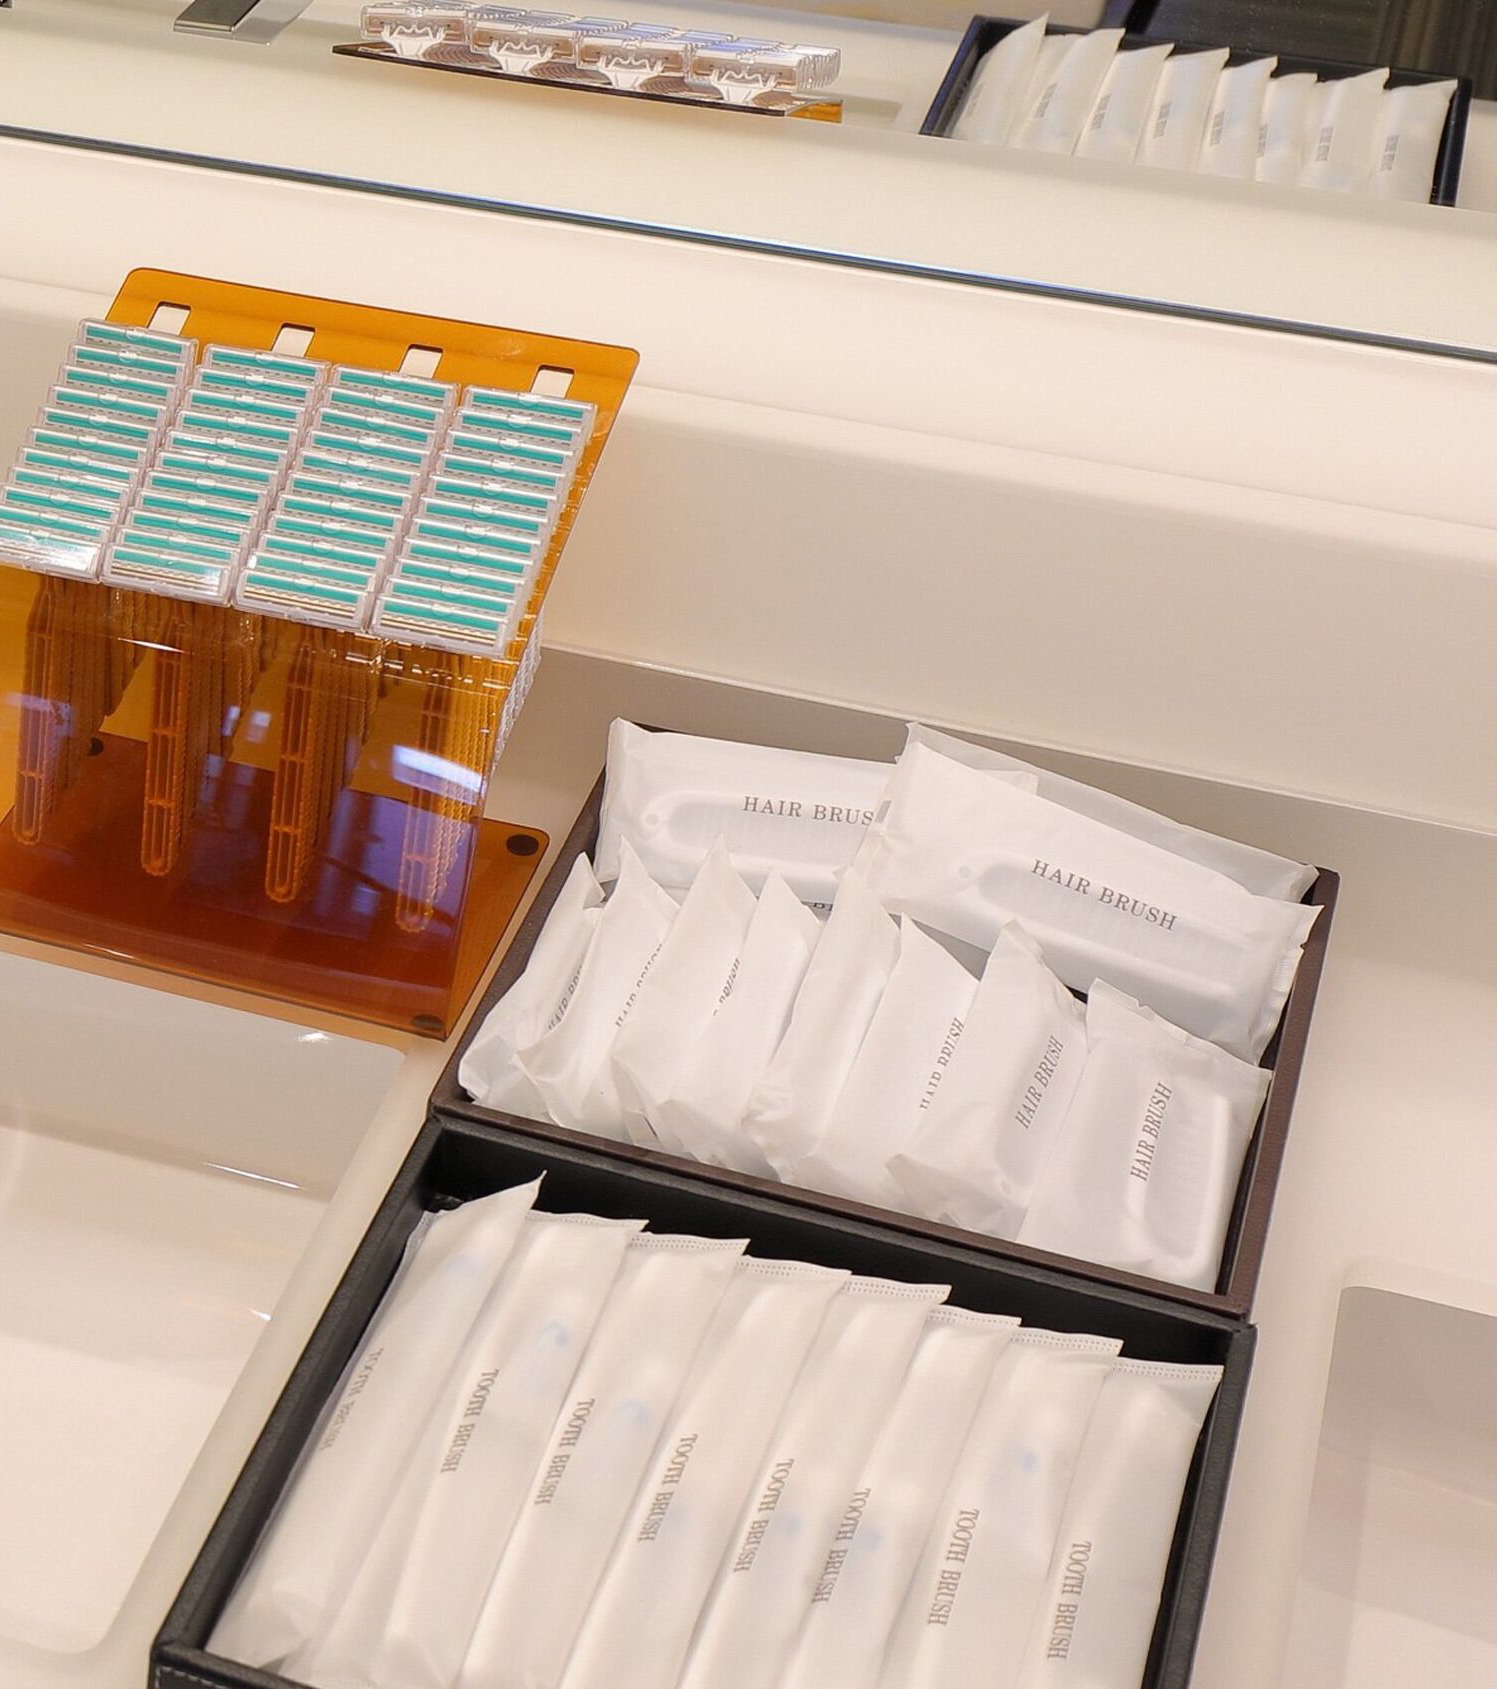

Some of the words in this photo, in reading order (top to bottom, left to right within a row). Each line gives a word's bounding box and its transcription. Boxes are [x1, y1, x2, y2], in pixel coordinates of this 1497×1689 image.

[742, 796, 802, 818] HAIR
[813, 804, 874, 827] BRUS
[1031, 859, 1091, 895] HAIR
[1098, 887, 1177, 931] BRUSH
[1015, 1085, 1043, 1130] HAIR
[1034, 1035, 1064, 1088] BRUSH
[1142, 1082, 1172, 1138] BRUSH
[1130, 1139, 1155, 1181] HAIR
[464, 1369, 499, 1418] TOOTH
[440, 1423, 475, 1474] BRUSH
[559, 1398, 595, 1447] TOOTH
[534, 1454, 570, 1506] BRUSH
[662, 1434, 698, 1485] TOOTH
[758, 1458, 794, 1512] TOOTH
[638, 1491, 674, 1543] BRUSH
[836, 1488, 871, 1543] TOOTH
[946, 1509, 980, 1564] TOOTH
[733, 1520, 769, 1573] BRUSH
[1062, 1541, 1092, 1596] TOOTH
[812, 1549, 848, 1604] BRUSH
[927, 1570, 962, 1626] BRUSH
[1047, 1603, 1078, 1660] BRUSH
